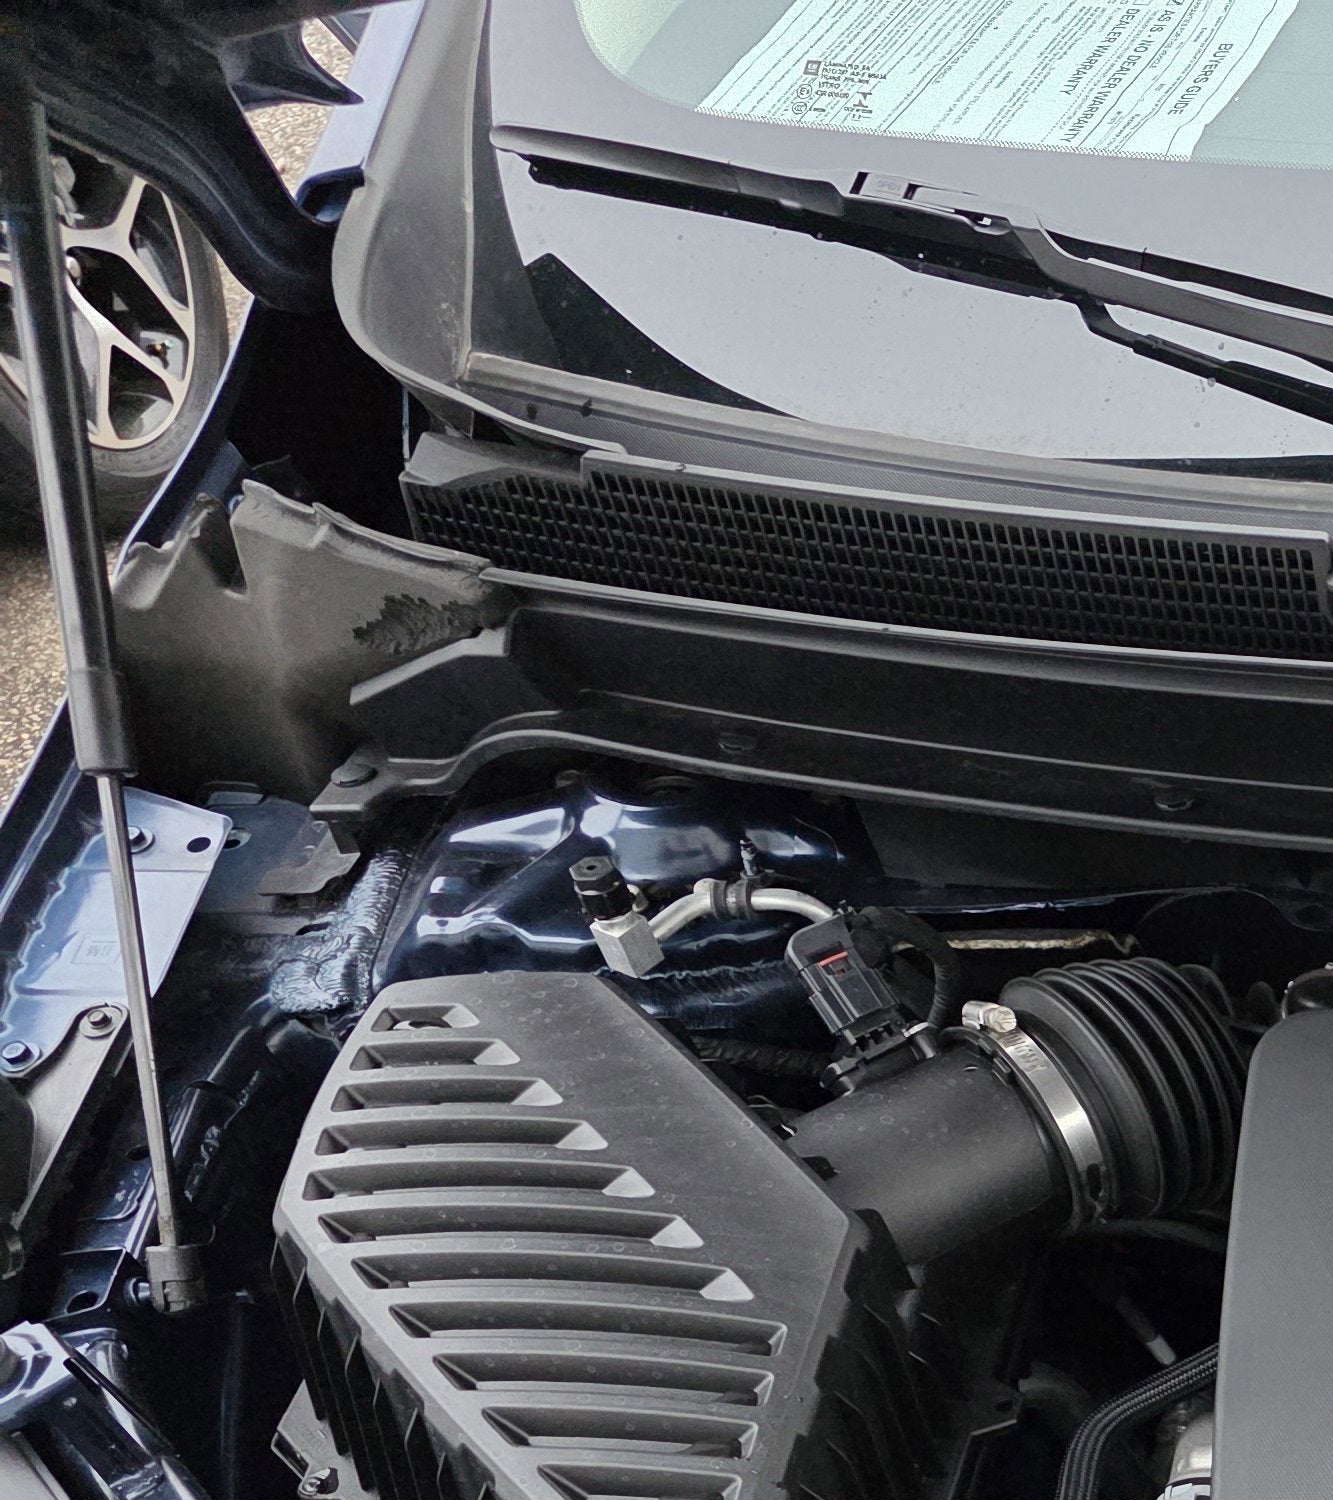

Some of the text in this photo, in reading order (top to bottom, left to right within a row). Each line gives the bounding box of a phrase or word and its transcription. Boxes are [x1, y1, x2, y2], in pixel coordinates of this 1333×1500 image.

[1150, 24, 1163, 34] IS
[1157, 9, 1175, 24] AS
[1059, 8, 1140, 95] DEALER WARRANTY
[1133, 40, 1155, 55] NO
[1101, 55, 1141, 89] DEALER
[1193, 43, 1234, 85] BUYERS
[1060, 89, 1112, 142] WARRANTY
[1168, 85, 1202, 116] GUIDE
